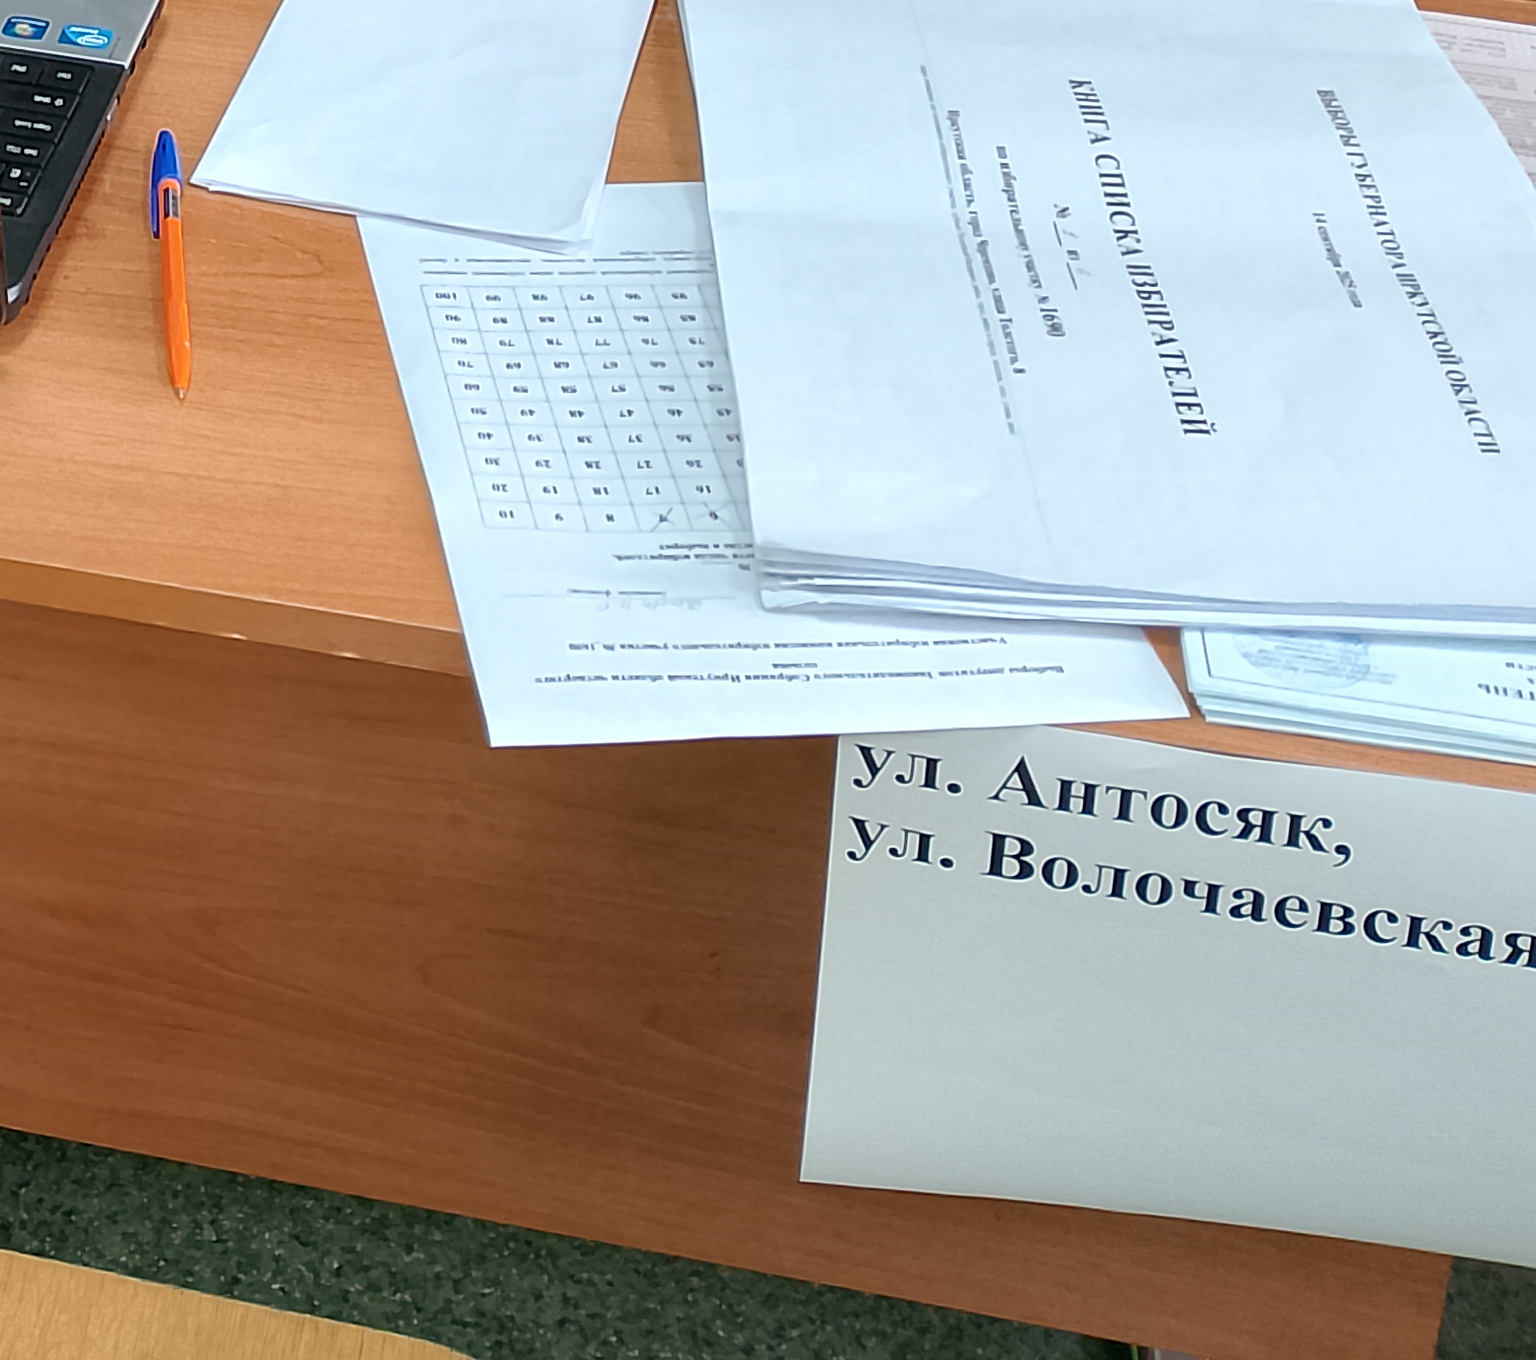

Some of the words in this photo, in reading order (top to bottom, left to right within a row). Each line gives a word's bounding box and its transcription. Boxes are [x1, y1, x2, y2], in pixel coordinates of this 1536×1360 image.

[1038, 307, 1067, 338] 1690
[1068, 78, 1113, 145] КНИГА
[1094, 153, 1142, 258] СПИСКА
[1124, 263, 1218, 437] ИЗБИРАТЕЛЕЙ
[1316, 89, 1361, 148] ВЫБОРЫ
[1345, 151, 1408, 270] ГУБЕРНАТОРА
[1444, 368, 1501, 455] ОБЛАСТИ
[851, 742, 964, 796] ул.
[987, 753, 1354, 870] Антосяк,
[846, 813, 957, 870] ул.
[981, 829, 1536, 970] Волочаевская
